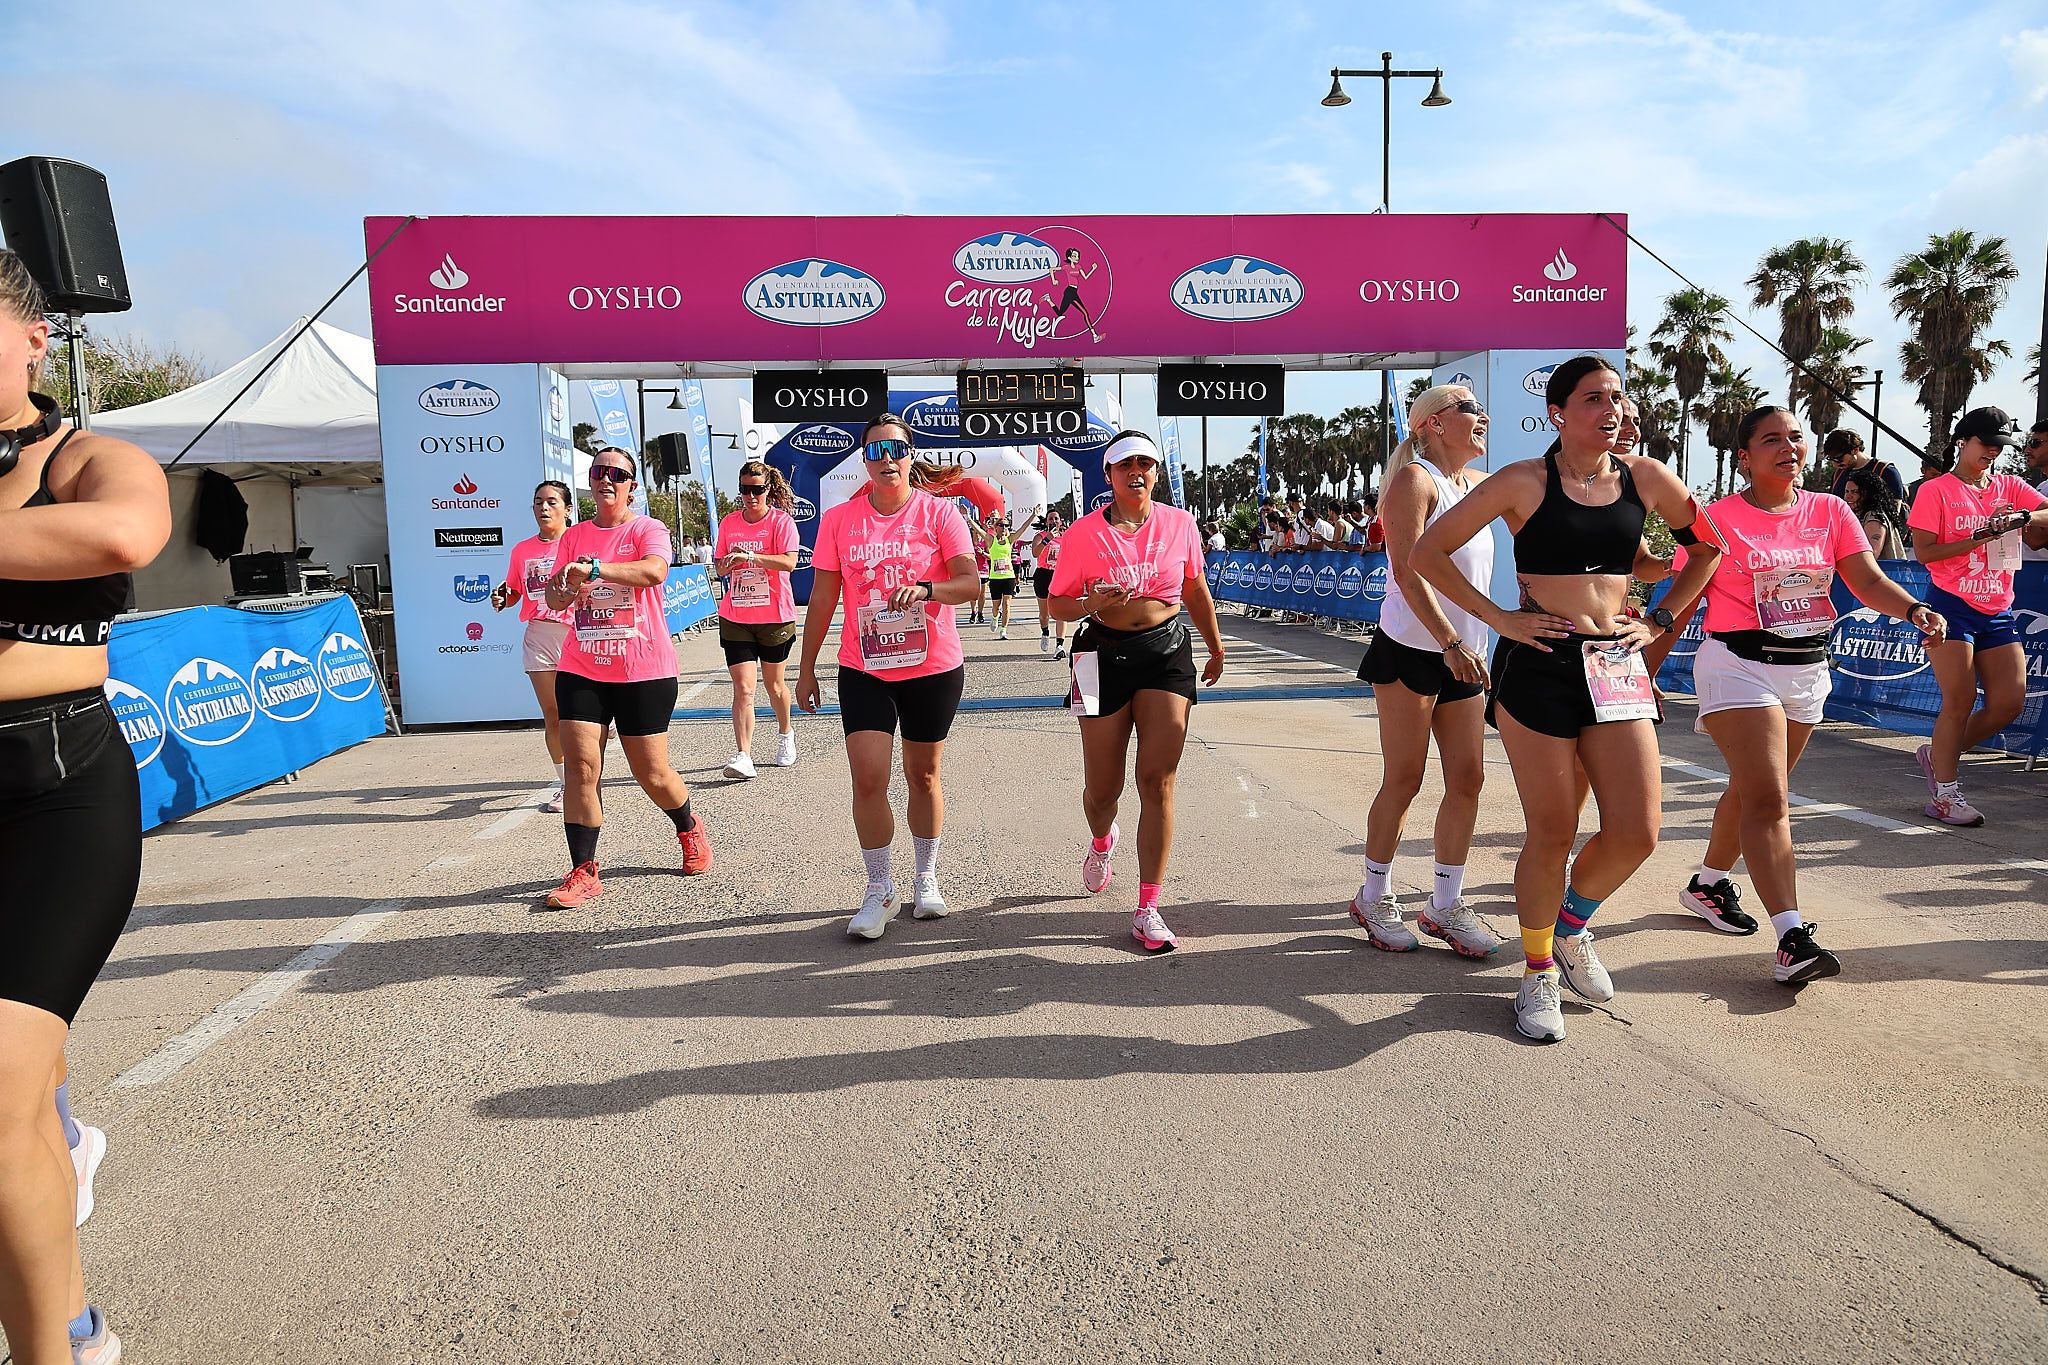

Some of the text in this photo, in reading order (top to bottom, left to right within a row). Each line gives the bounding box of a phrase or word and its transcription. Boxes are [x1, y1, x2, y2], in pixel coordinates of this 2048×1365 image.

[961, 250, 1051, 271] ASTURIANA
[1201, 278, 1244, 286] CENTRAL
[1359, 279, 1460, 303] OYSHO
[568, 286, 682, 310] OYSHO
[754, 283, 876, 309] ASTURIANA
[945, 280, 1033, 308] Carrera
[1181, 280, 1294, 305] ASTURIANA
[1512, 285, 1608, 303] Santander
[395, 293, 506, 313] Santander
[967, 308, 999, 328] de la
[997, 303, 1066, 349] Mujer
[966, 373, 1076, 403] 00:37:05
[1178, 380, 1267, 401] OYSHO
[425, 393, 495, 408] ASTURIANA
[774, 387, 869, 408] OYSHO
[909, 408, 960, 428] ASTUR
[965, 410, 1082, 437] OYSHO
[420, 435, 505, 454] OYSHO
[793, 435, 850, 448] ASTURIANA
[1055, 431, 1110, 446] ASTURIANA
[829, 473, 858, 481] OYSHO
[1002, 469, 1030, 477] OYSHO
[432, 497, 502, 510] Santander
[438, 532, 500, 545] Neutrogena
[849, 540, 912, 562] CARRERA
[1747, 545, 1828, 570] CARRERA
[456, 580, 489, 596] Marlene
[539, 575, 549, 583] 01
[1958, 576, 2005, 594] MUJER
[741, 585, 756, 593] 016
[1781, 598, 1811, 612] 016
[1974, 594, 1991, 603] 2026
[592, 608, 615, 619] 016
[879, 632, 906, 645] 016
[1849, 626, 1919, 640] CENTRAL LECHE
[438, 643, 514, 654] octopus energy
[580, 640, 627, 656] MUJER
[1829, 626, 1926, 665] ASTURIANA
[594, 656, 612, 666] 2026
[322, 661, 374, 689] ASTURIANA
[1610, 676, 1638, 691] 016
[183, 681, 242, 701] CENTRAL LECHERA
[173, 692, 252, 731] ASTURIANA
